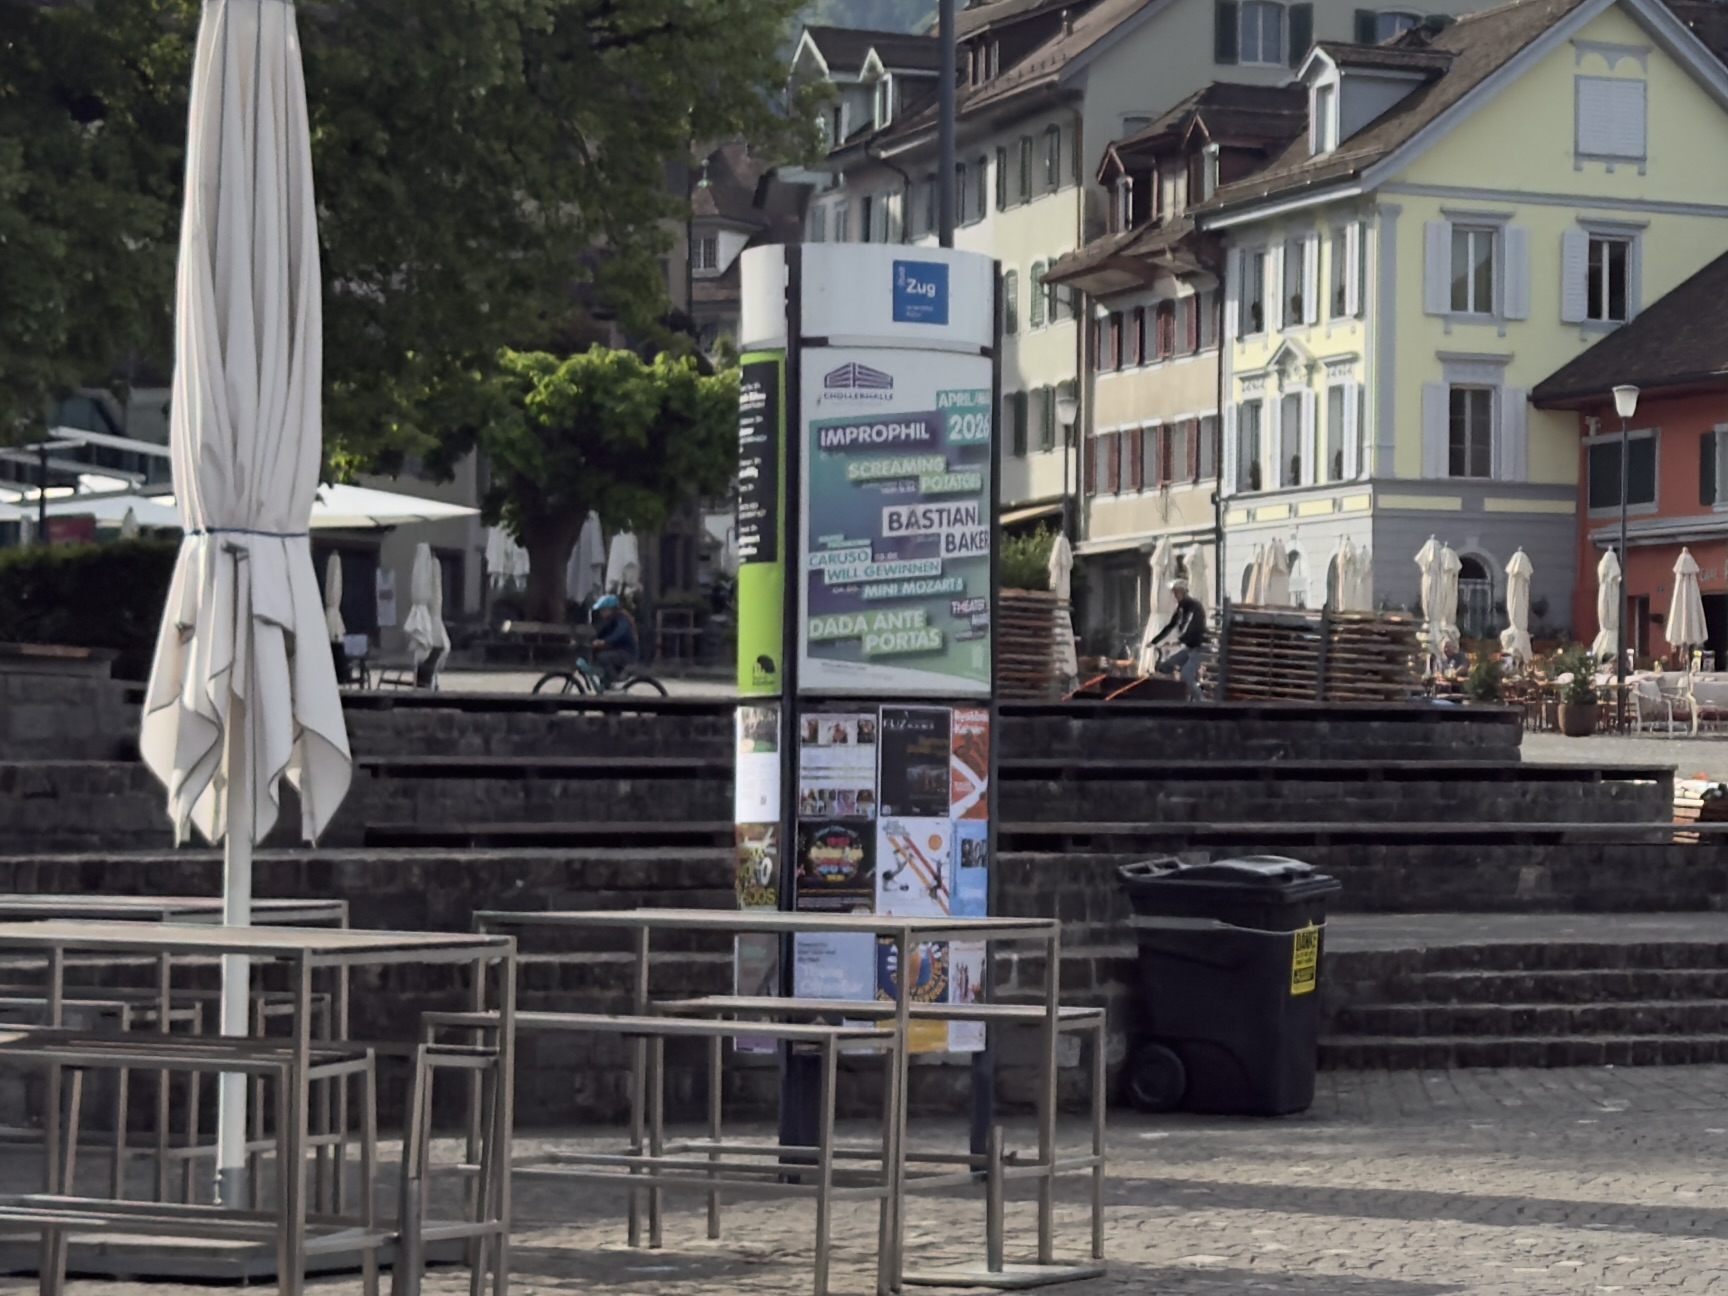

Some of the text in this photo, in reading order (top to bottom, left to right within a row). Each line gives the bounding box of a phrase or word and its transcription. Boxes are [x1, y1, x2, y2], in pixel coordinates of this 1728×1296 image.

[906, 278, 936, 298] Zug
[820, 422, 930, 447] IMPROPHIL
[949, 413, 990, 440] 2026
[848, 456, 945, 479] SCREAMING
[888, 507, 976, 532] BASTIAN
[945, 531, 990, 554] BAKER
[808, 550, 869, 567] CARUSO
[827, 561, 940, 582] WILL GEWINNEN
[863, 583, 898, 600] MINI
[809, 609, 925, 639] DADA ANTE
[866, 628, 942, 652] PORTAS
